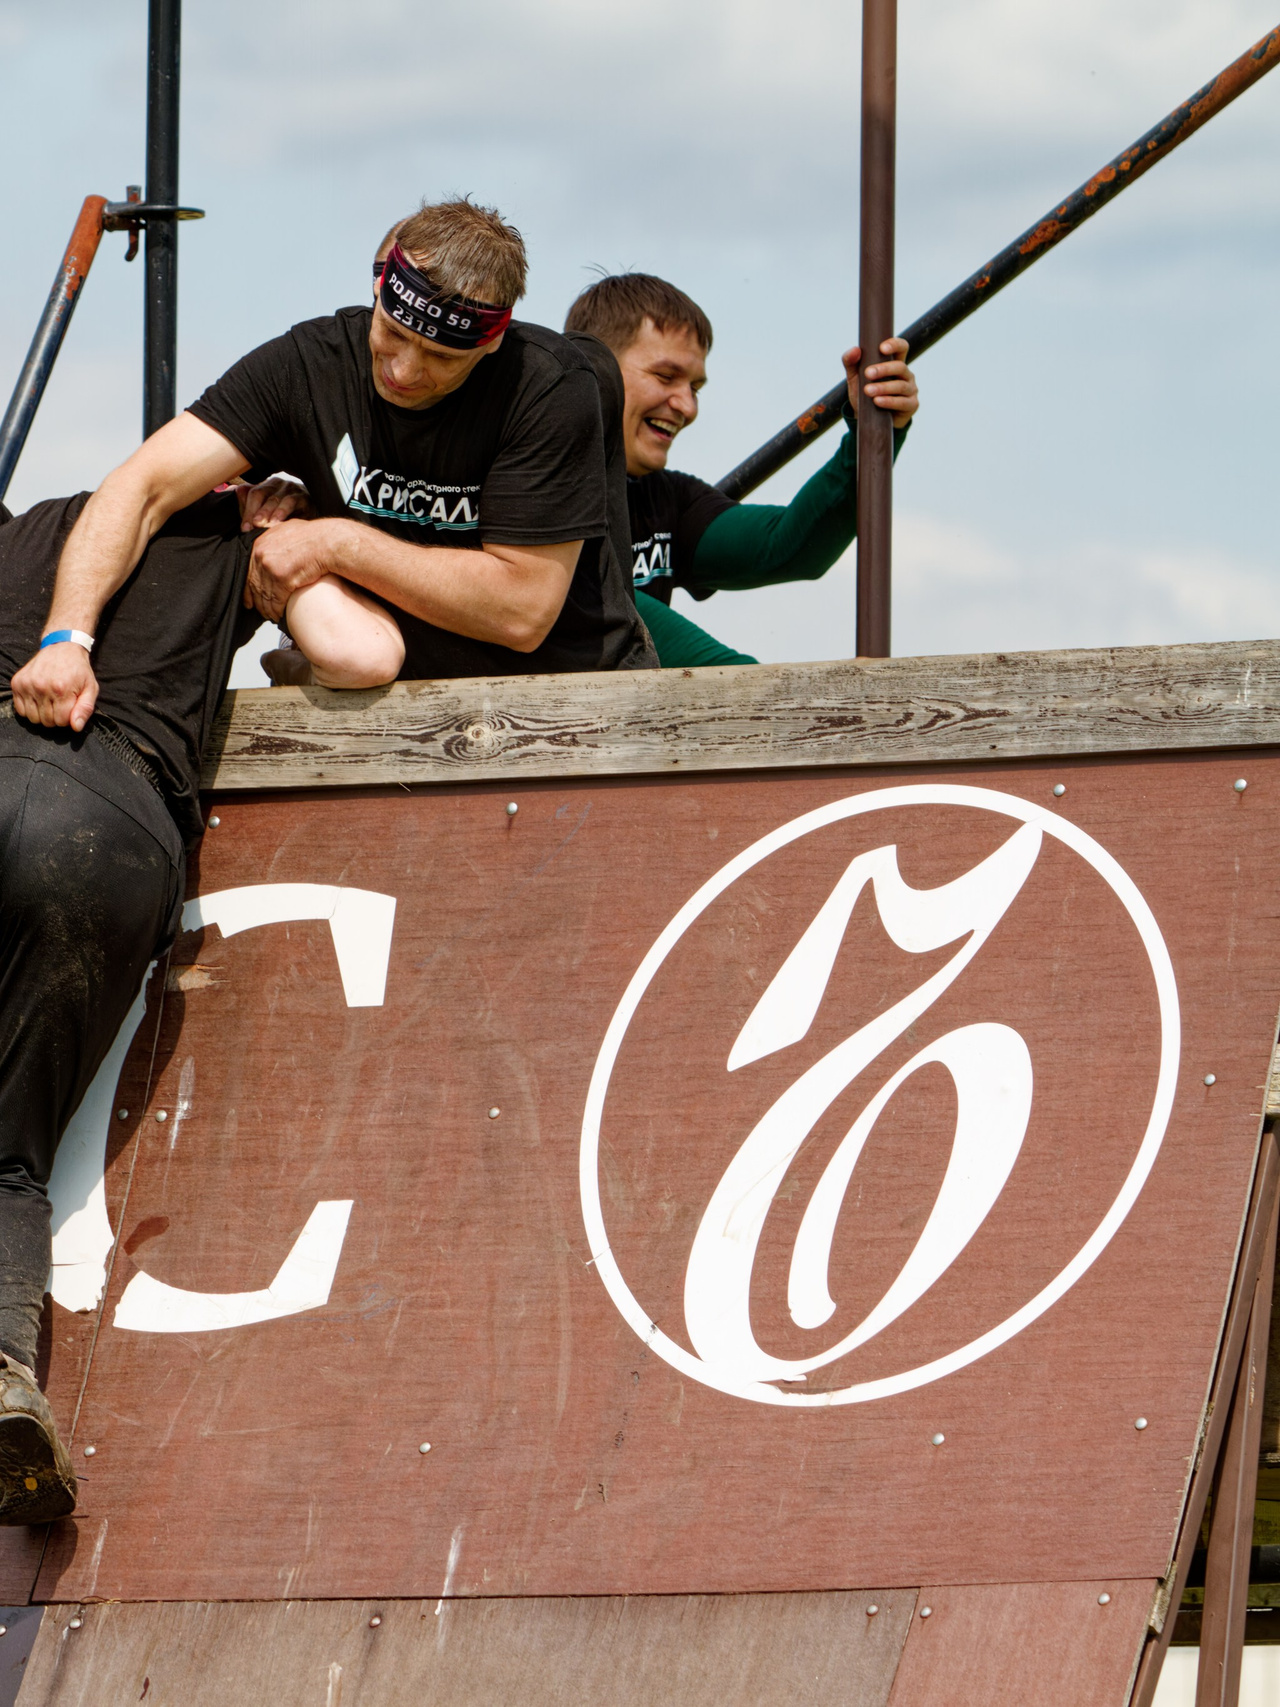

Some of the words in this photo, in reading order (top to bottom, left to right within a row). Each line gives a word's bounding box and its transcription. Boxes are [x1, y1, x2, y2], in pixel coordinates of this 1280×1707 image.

[388, 273, 442, 318] РОДЕО
[446, 313, 472, 330] 59
[392, 304, 439, 338] 2319
